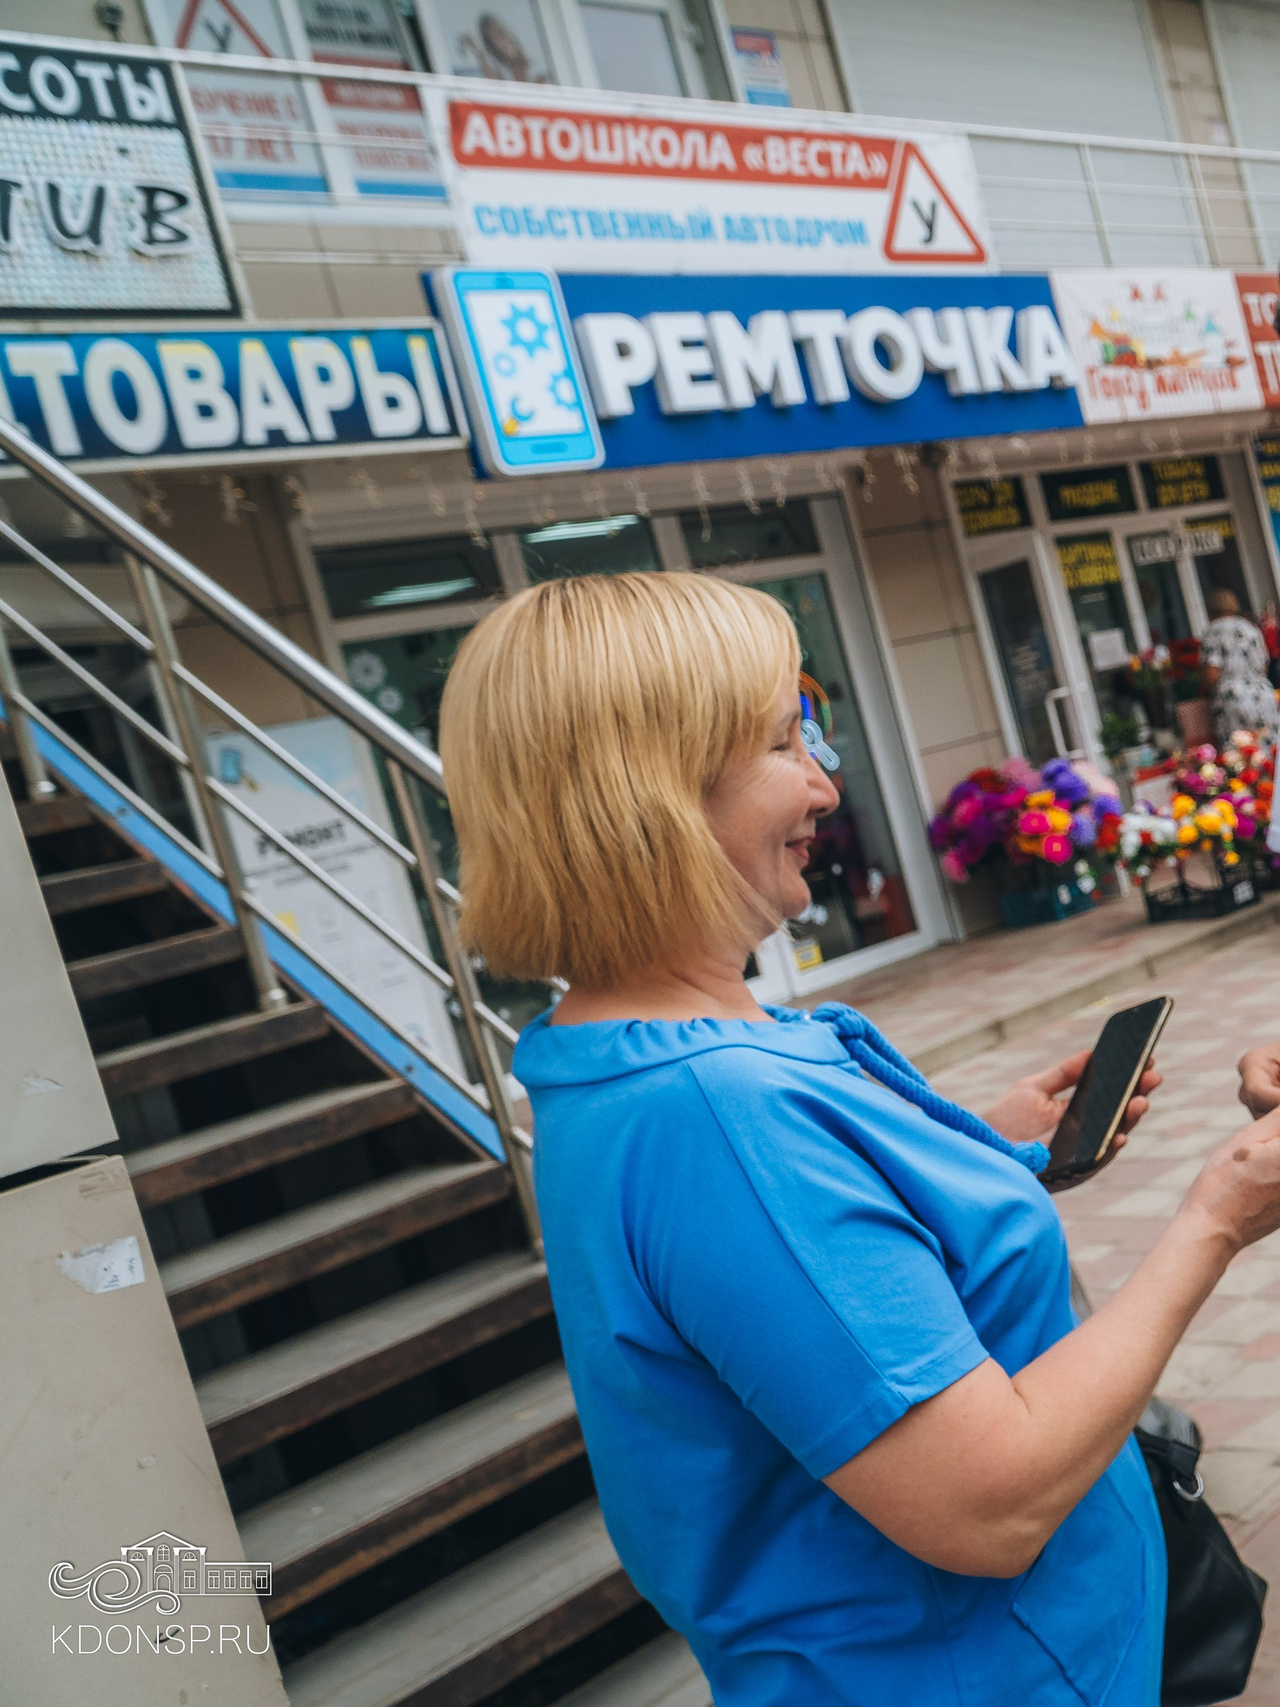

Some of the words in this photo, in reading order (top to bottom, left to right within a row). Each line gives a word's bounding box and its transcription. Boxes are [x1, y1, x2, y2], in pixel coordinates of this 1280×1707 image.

[461, 110, 737, 173] АВТОШКОЛА
[742, 136, 889, 182] «ВЕСТА»
[474, 204, 718, 243] СОБСТВЕННЫЙ
[724, 213, 869, 249] АВТОДРОМ
[910, 200, 938, 245] У
[577, 307, 1079, 420] РЕМТОЧКА
[0, 336, 451, 456] ТОВАРЫ
[255, 819, 344, 856] РМОНТ
